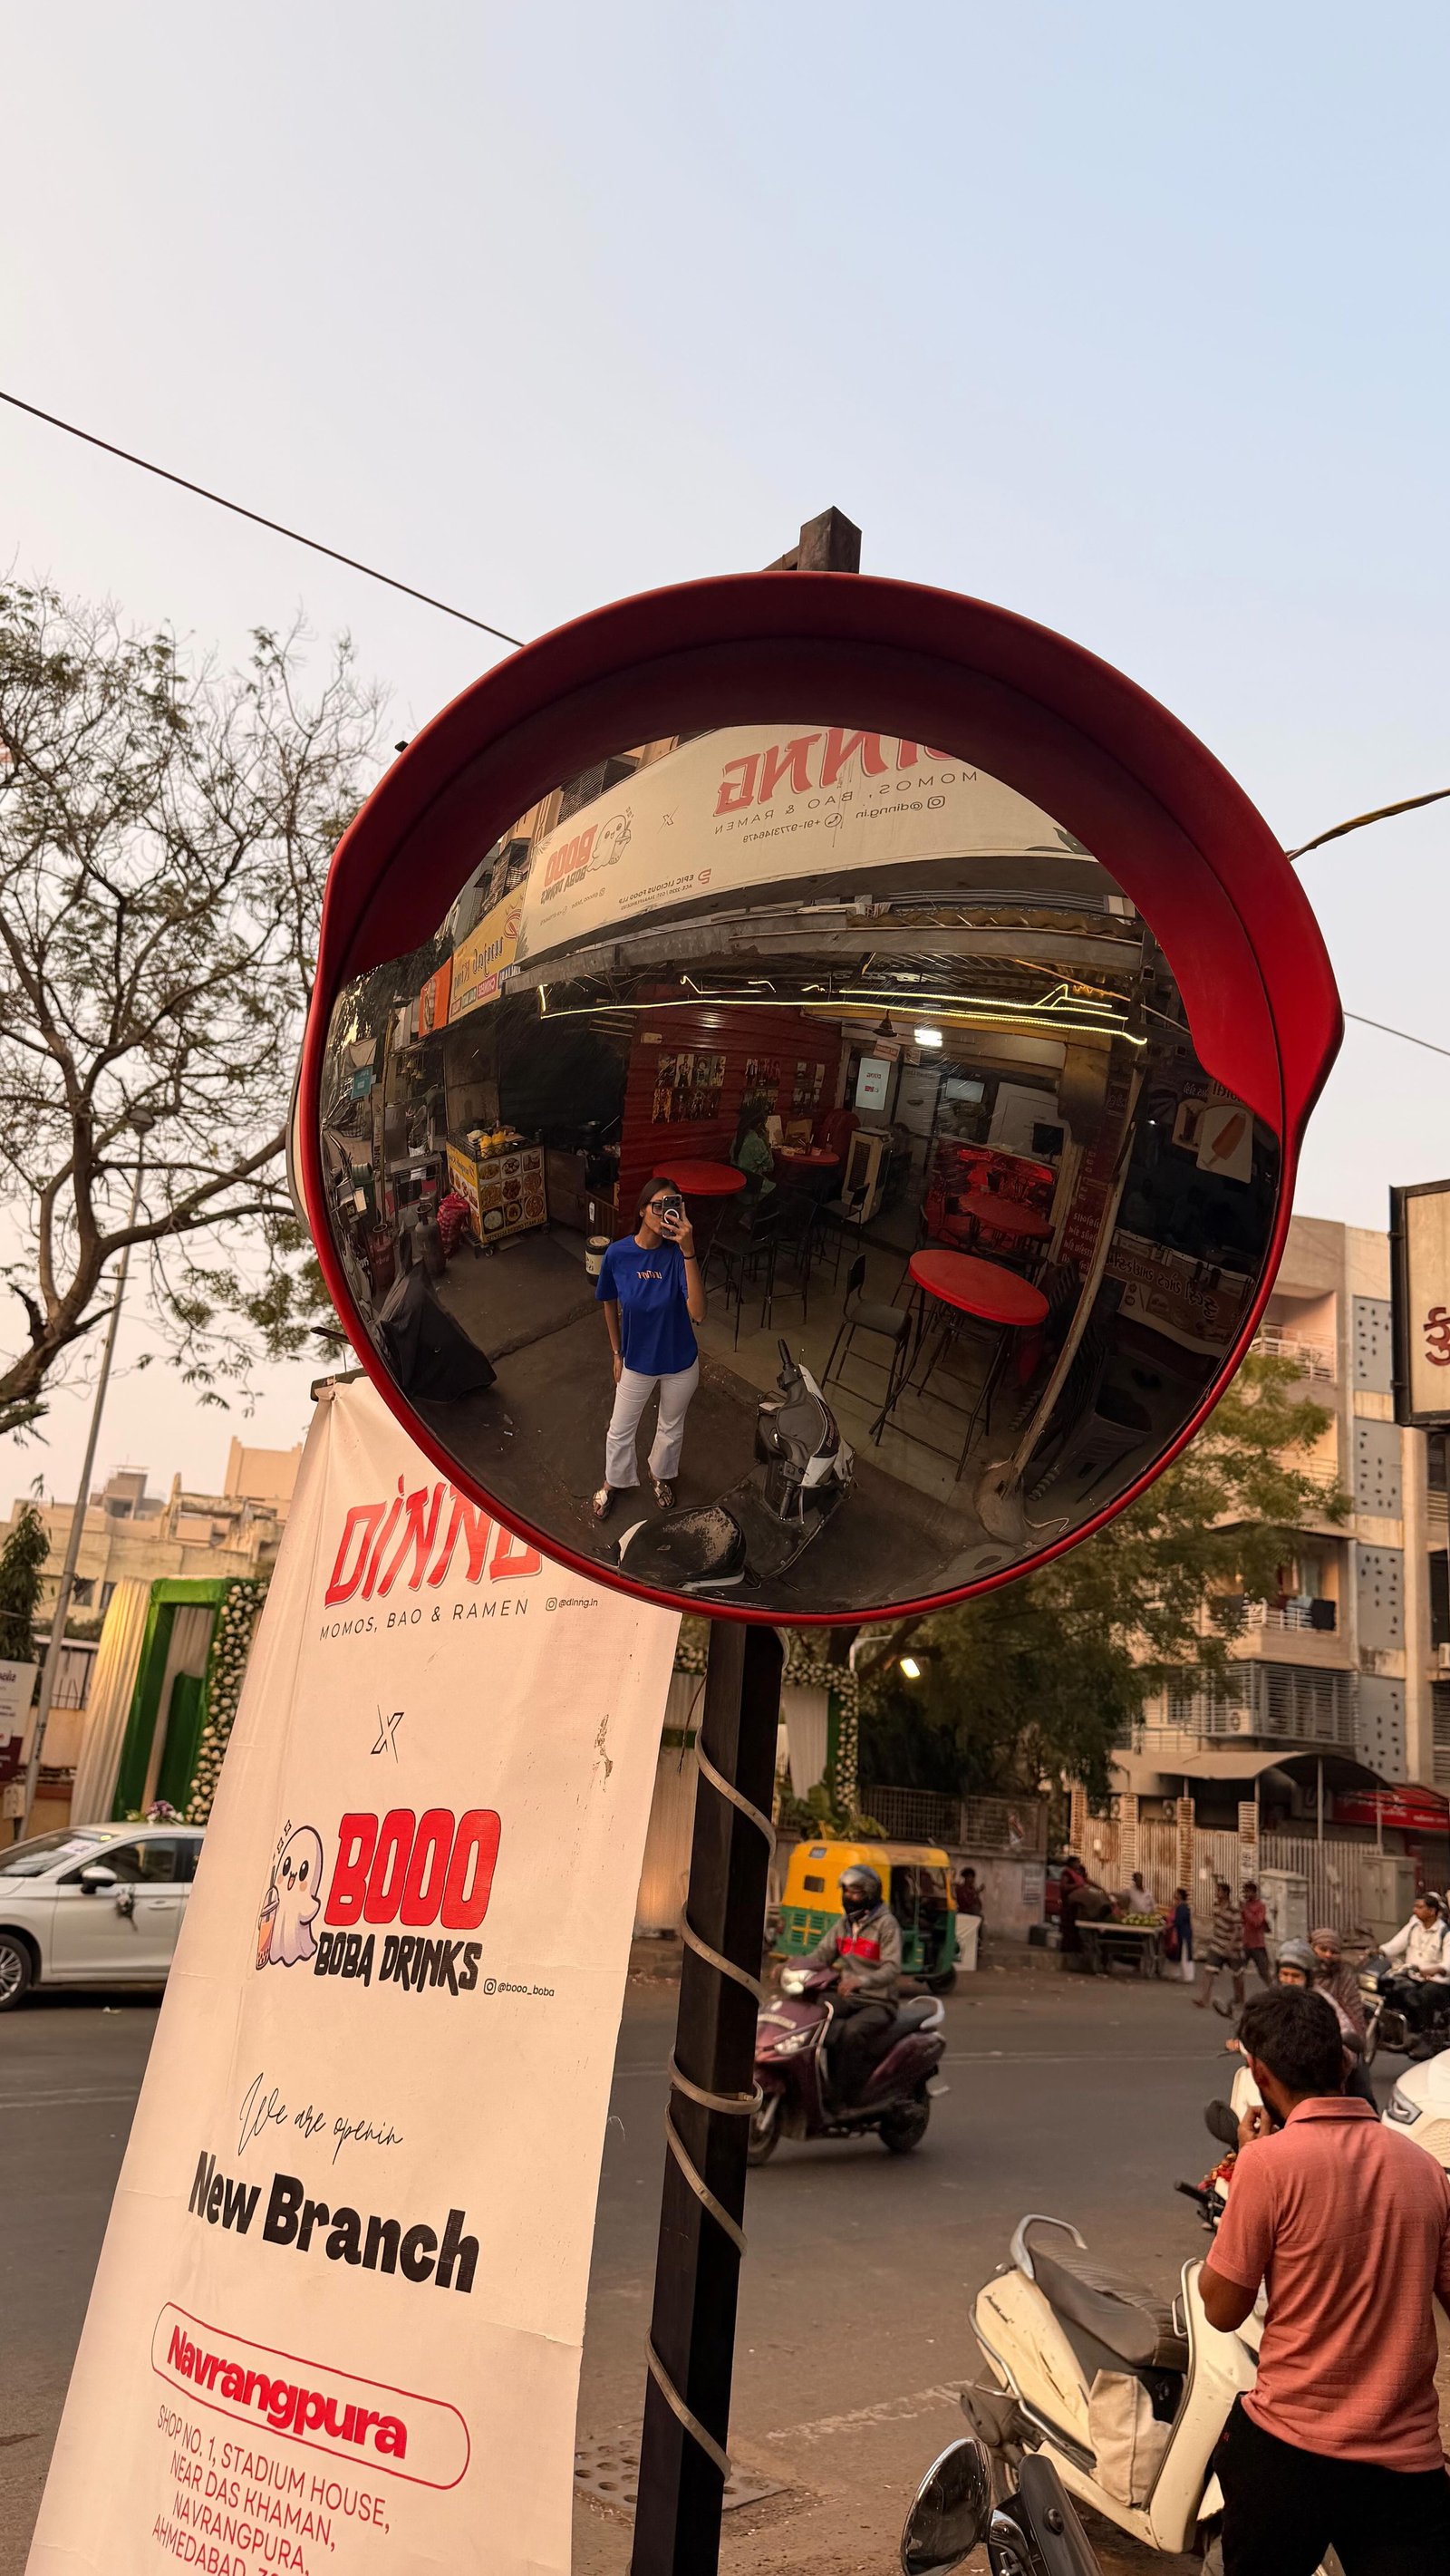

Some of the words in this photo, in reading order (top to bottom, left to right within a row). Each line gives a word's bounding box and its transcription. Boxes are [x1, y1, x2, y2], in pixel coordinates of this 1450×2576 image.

[319, 1616, 378, 1641] MOMOS,
[387, 1608, 422, 1628] BAO
[430, 1605, 441, 1622] &
[452, 1598, 529, 1621] RAMEN
[324, 1808, 501, 1930] BOOO
[314, 1932, 375, 1987] BOBA
[379, 1934, 483, 1997] DRINKS
[498, 1982, 555, 1997] @booo_boba
[237, 2072, 288, 2156] We
[295, 2105, 326, 2139] are
[332, 2116, 404, 2165] openin
[188, 2150, 262, 2235] New
[262, 2172, 479, 2294] Branch
[167, 2325, 408, 2460] Navrangpura
[158, 2405, 183, 2440] SHOP
[182, 2423, 203, 2457] NO.
[208, 2436, 217, 2467] 1,
[221, 2443, 305, 2498] STADIUM
[310, 2475, 390, 2534] HOUSE,
[170, 2450, 203, 2492] NEAR
[205, 2470, 240, 2508] DAS
[243, 2487, 335, 2552] KHAMAN,
[152, 2513, 246, 2576] AHMEDABAD
[172, 2490, 310, 2576] NAVRANGPURA,
